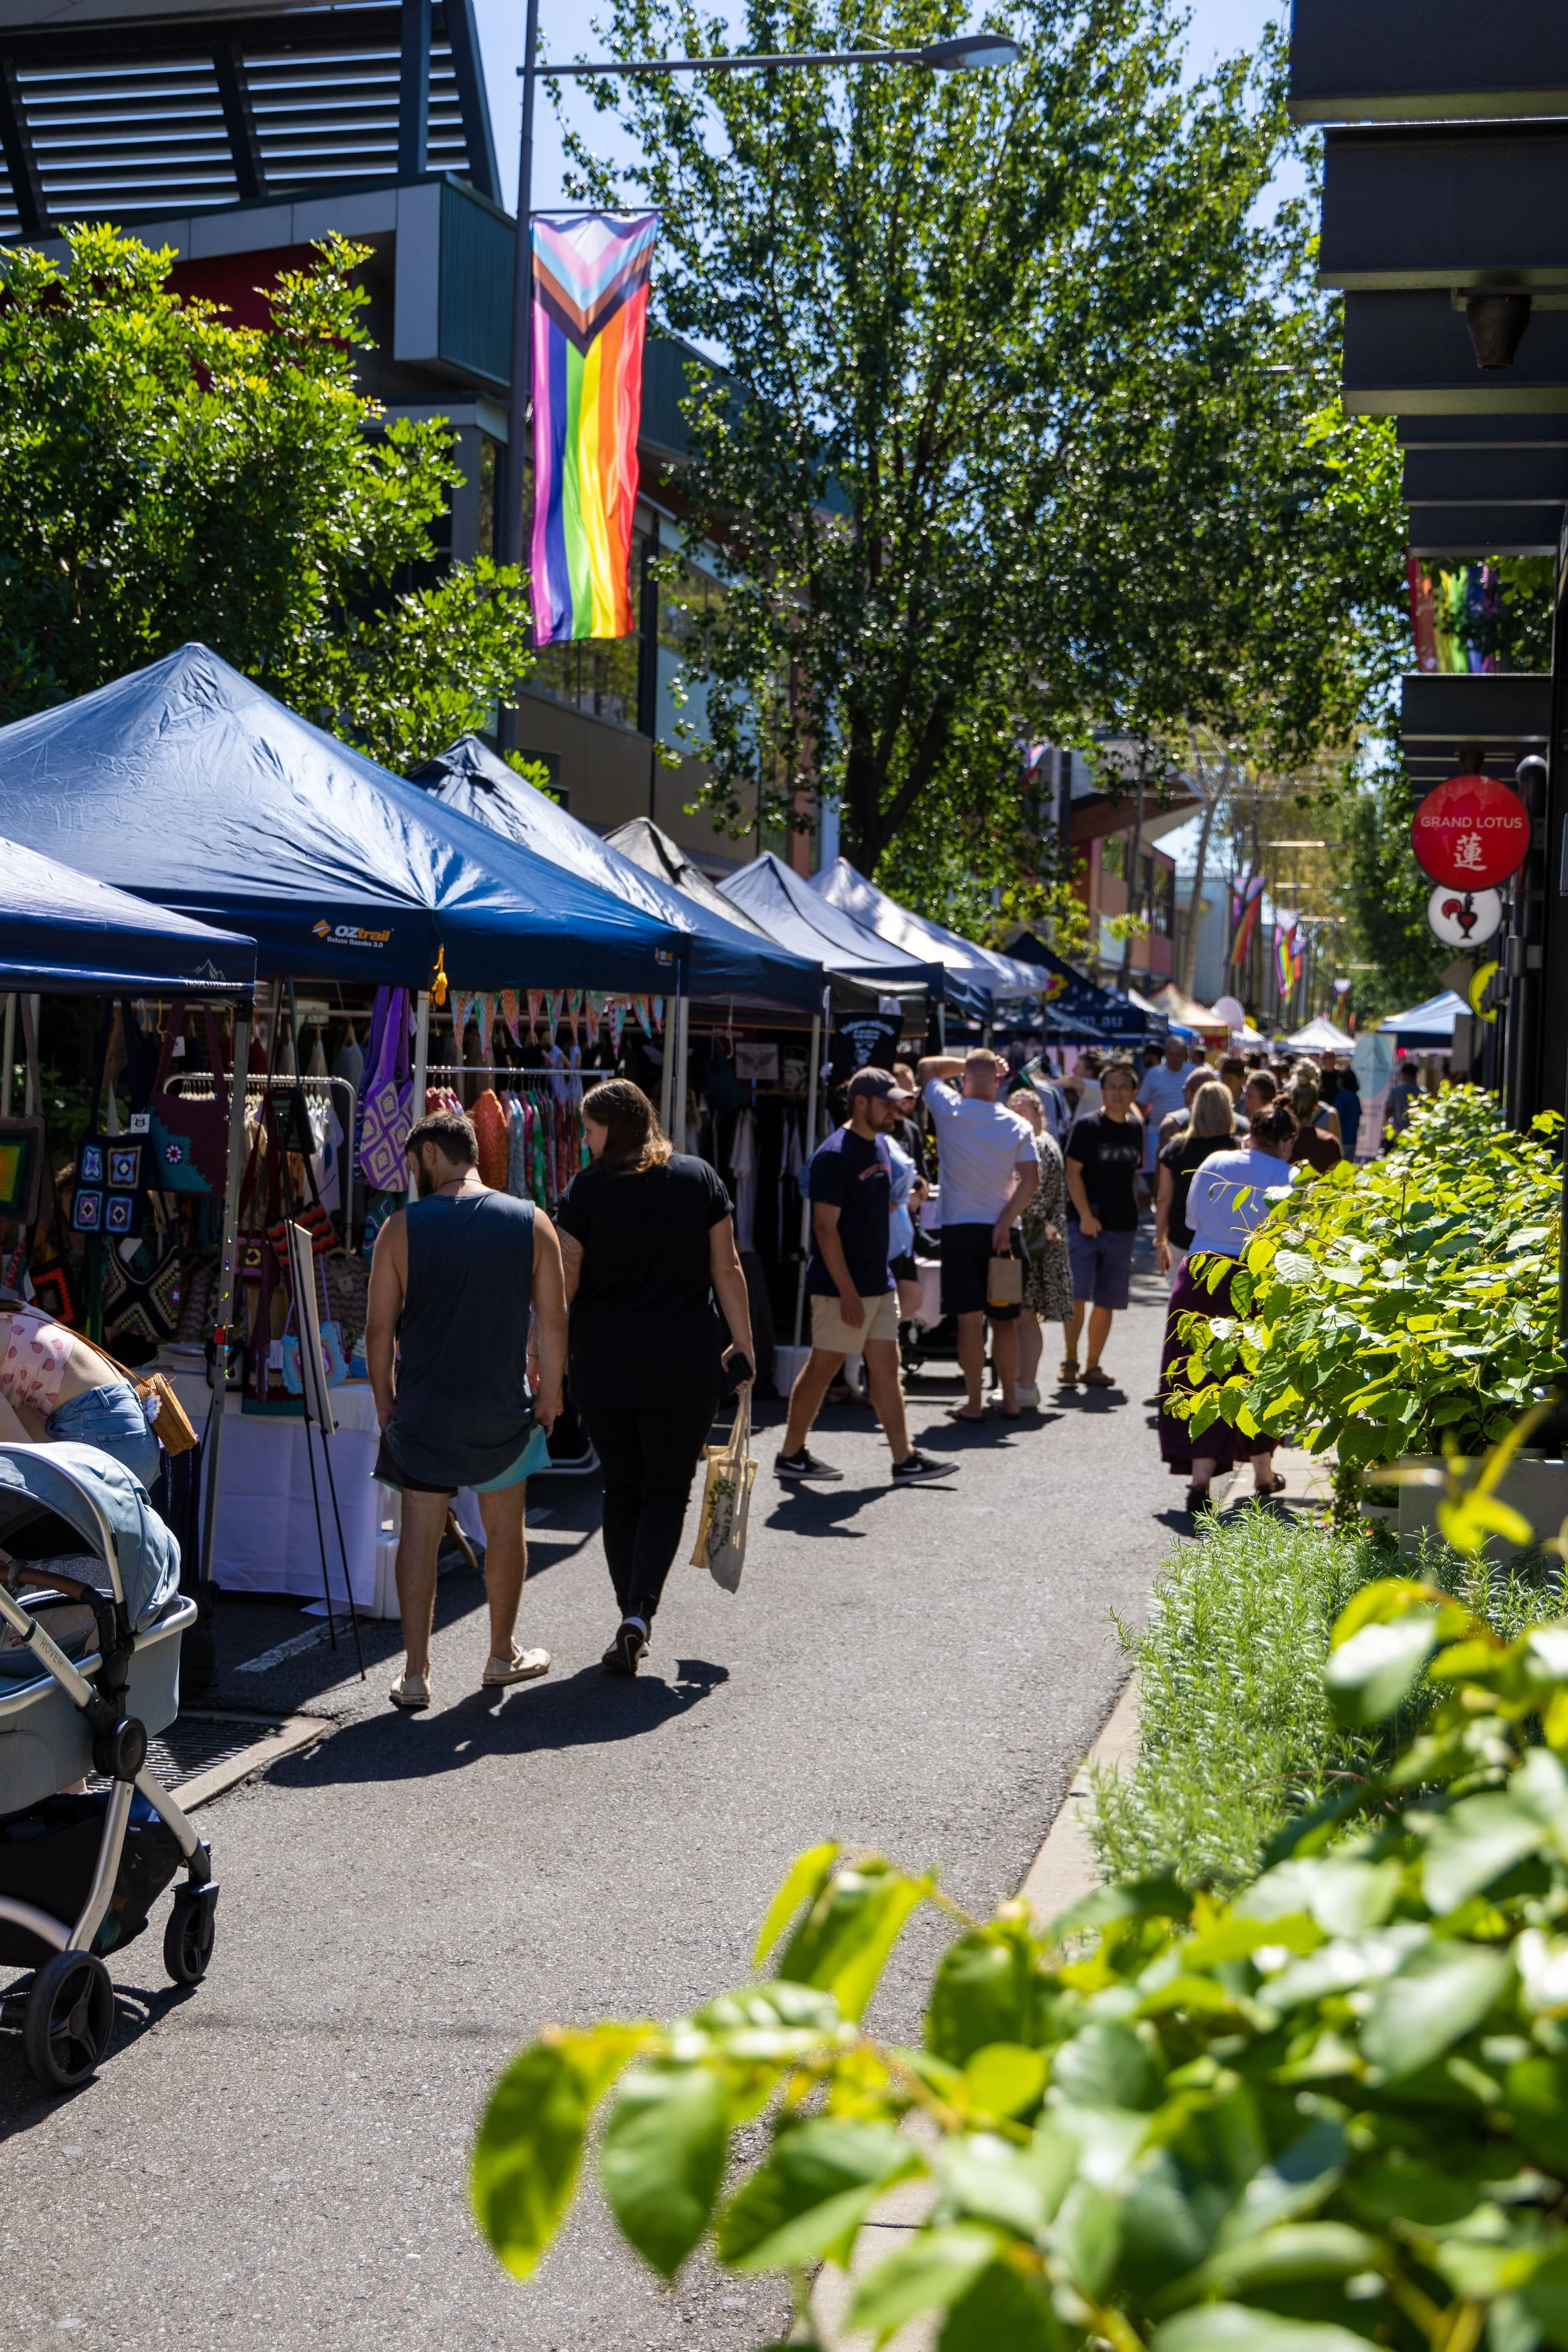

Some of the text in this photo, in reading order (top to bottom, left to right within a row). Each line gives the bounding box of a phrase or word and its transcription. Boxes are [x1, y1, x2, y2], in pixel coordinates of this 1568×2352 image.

[1420, 816, 1523, 829] GRAND LOTUS
[1453, 831, 1488, 871] 蓮
[327, 936, 348, 945] Deluxe
[349, 938, 373, 947] Gazebo
[334, 925, 391, 942] OZtrail
[40, 1637, 63, 1669] ROVER
